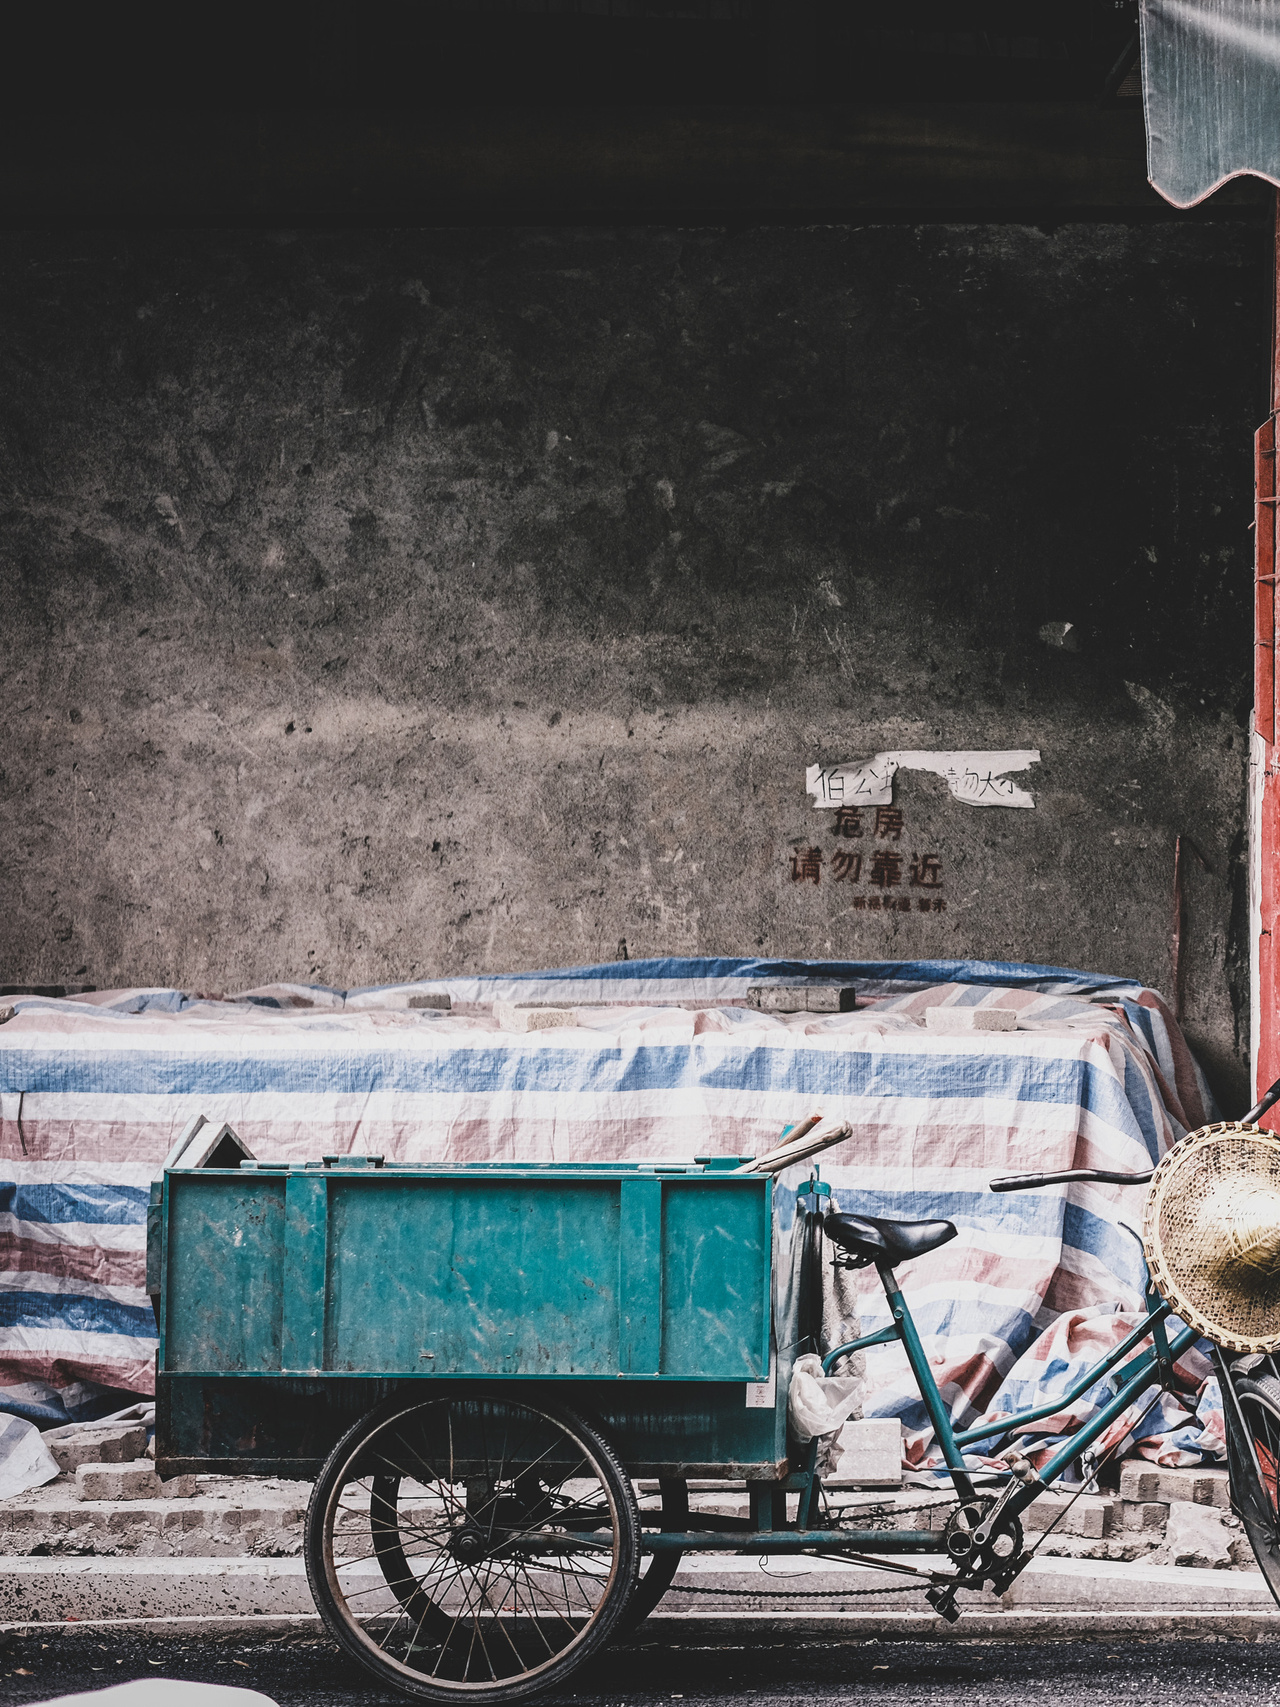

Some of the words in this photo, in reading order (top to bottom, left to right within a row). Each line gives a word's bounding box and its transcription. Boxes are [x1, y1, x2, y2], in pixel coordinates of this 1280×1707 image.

[833, 805, 904, 841] 危房
[790, 846, 944, 888] 请勿靠近
